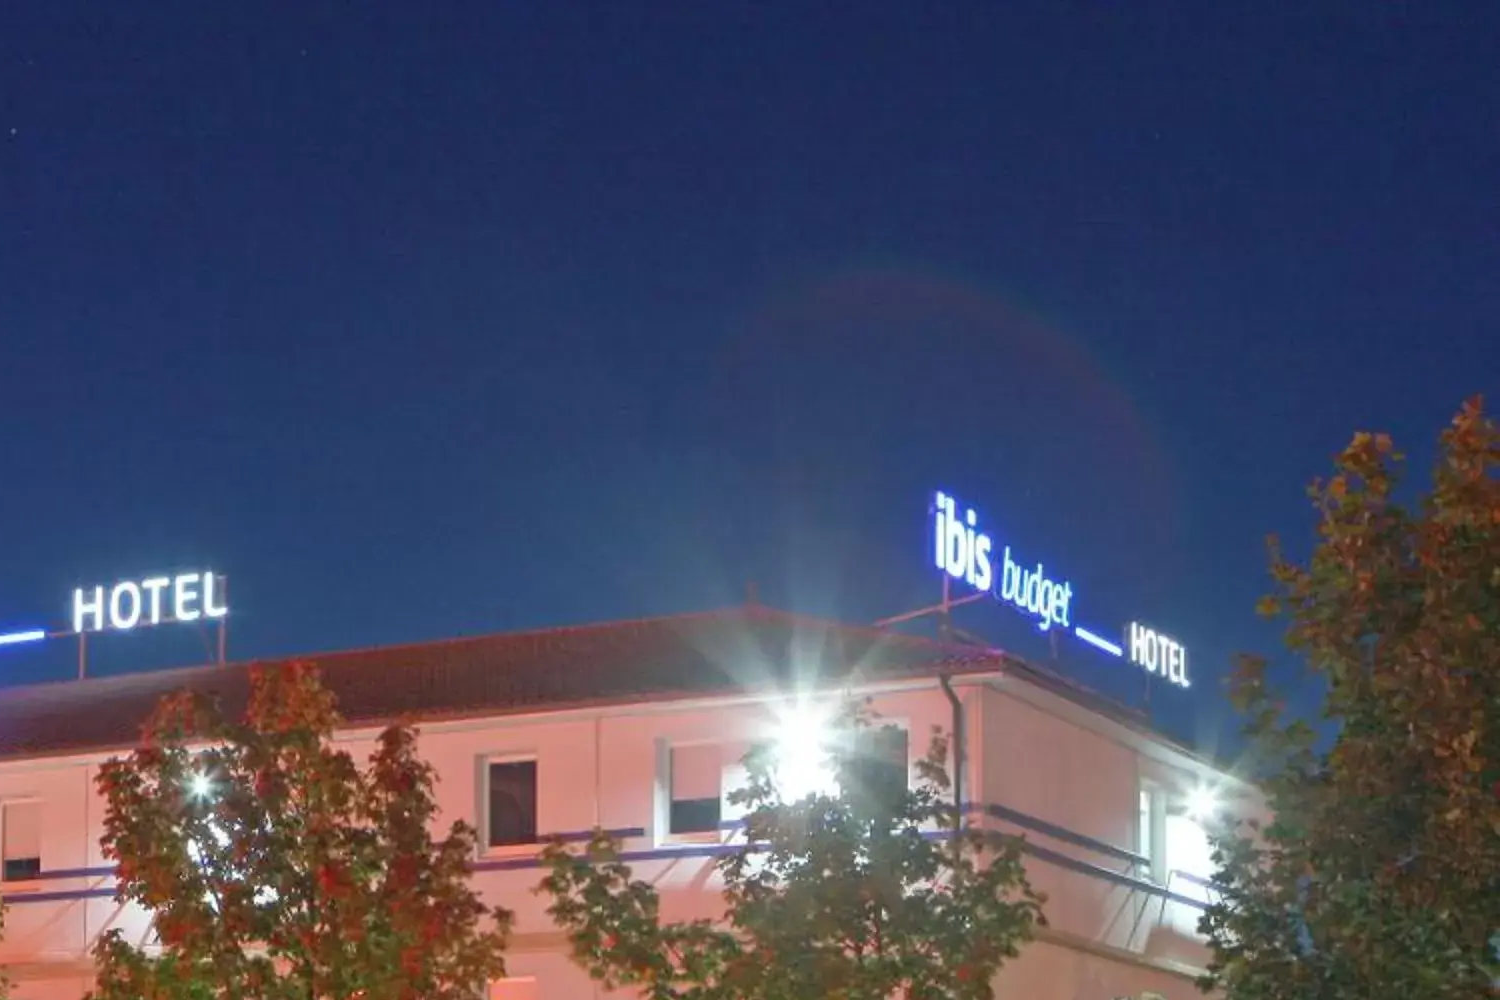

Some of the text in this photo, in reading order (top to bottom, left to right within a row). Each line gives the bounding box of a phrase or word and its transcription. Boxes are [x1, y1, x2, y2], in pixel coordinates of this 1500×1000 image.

[73, 570, 228, 633] HOTEL
[934, 490, 1191, 688] ibis budget HOTEL
